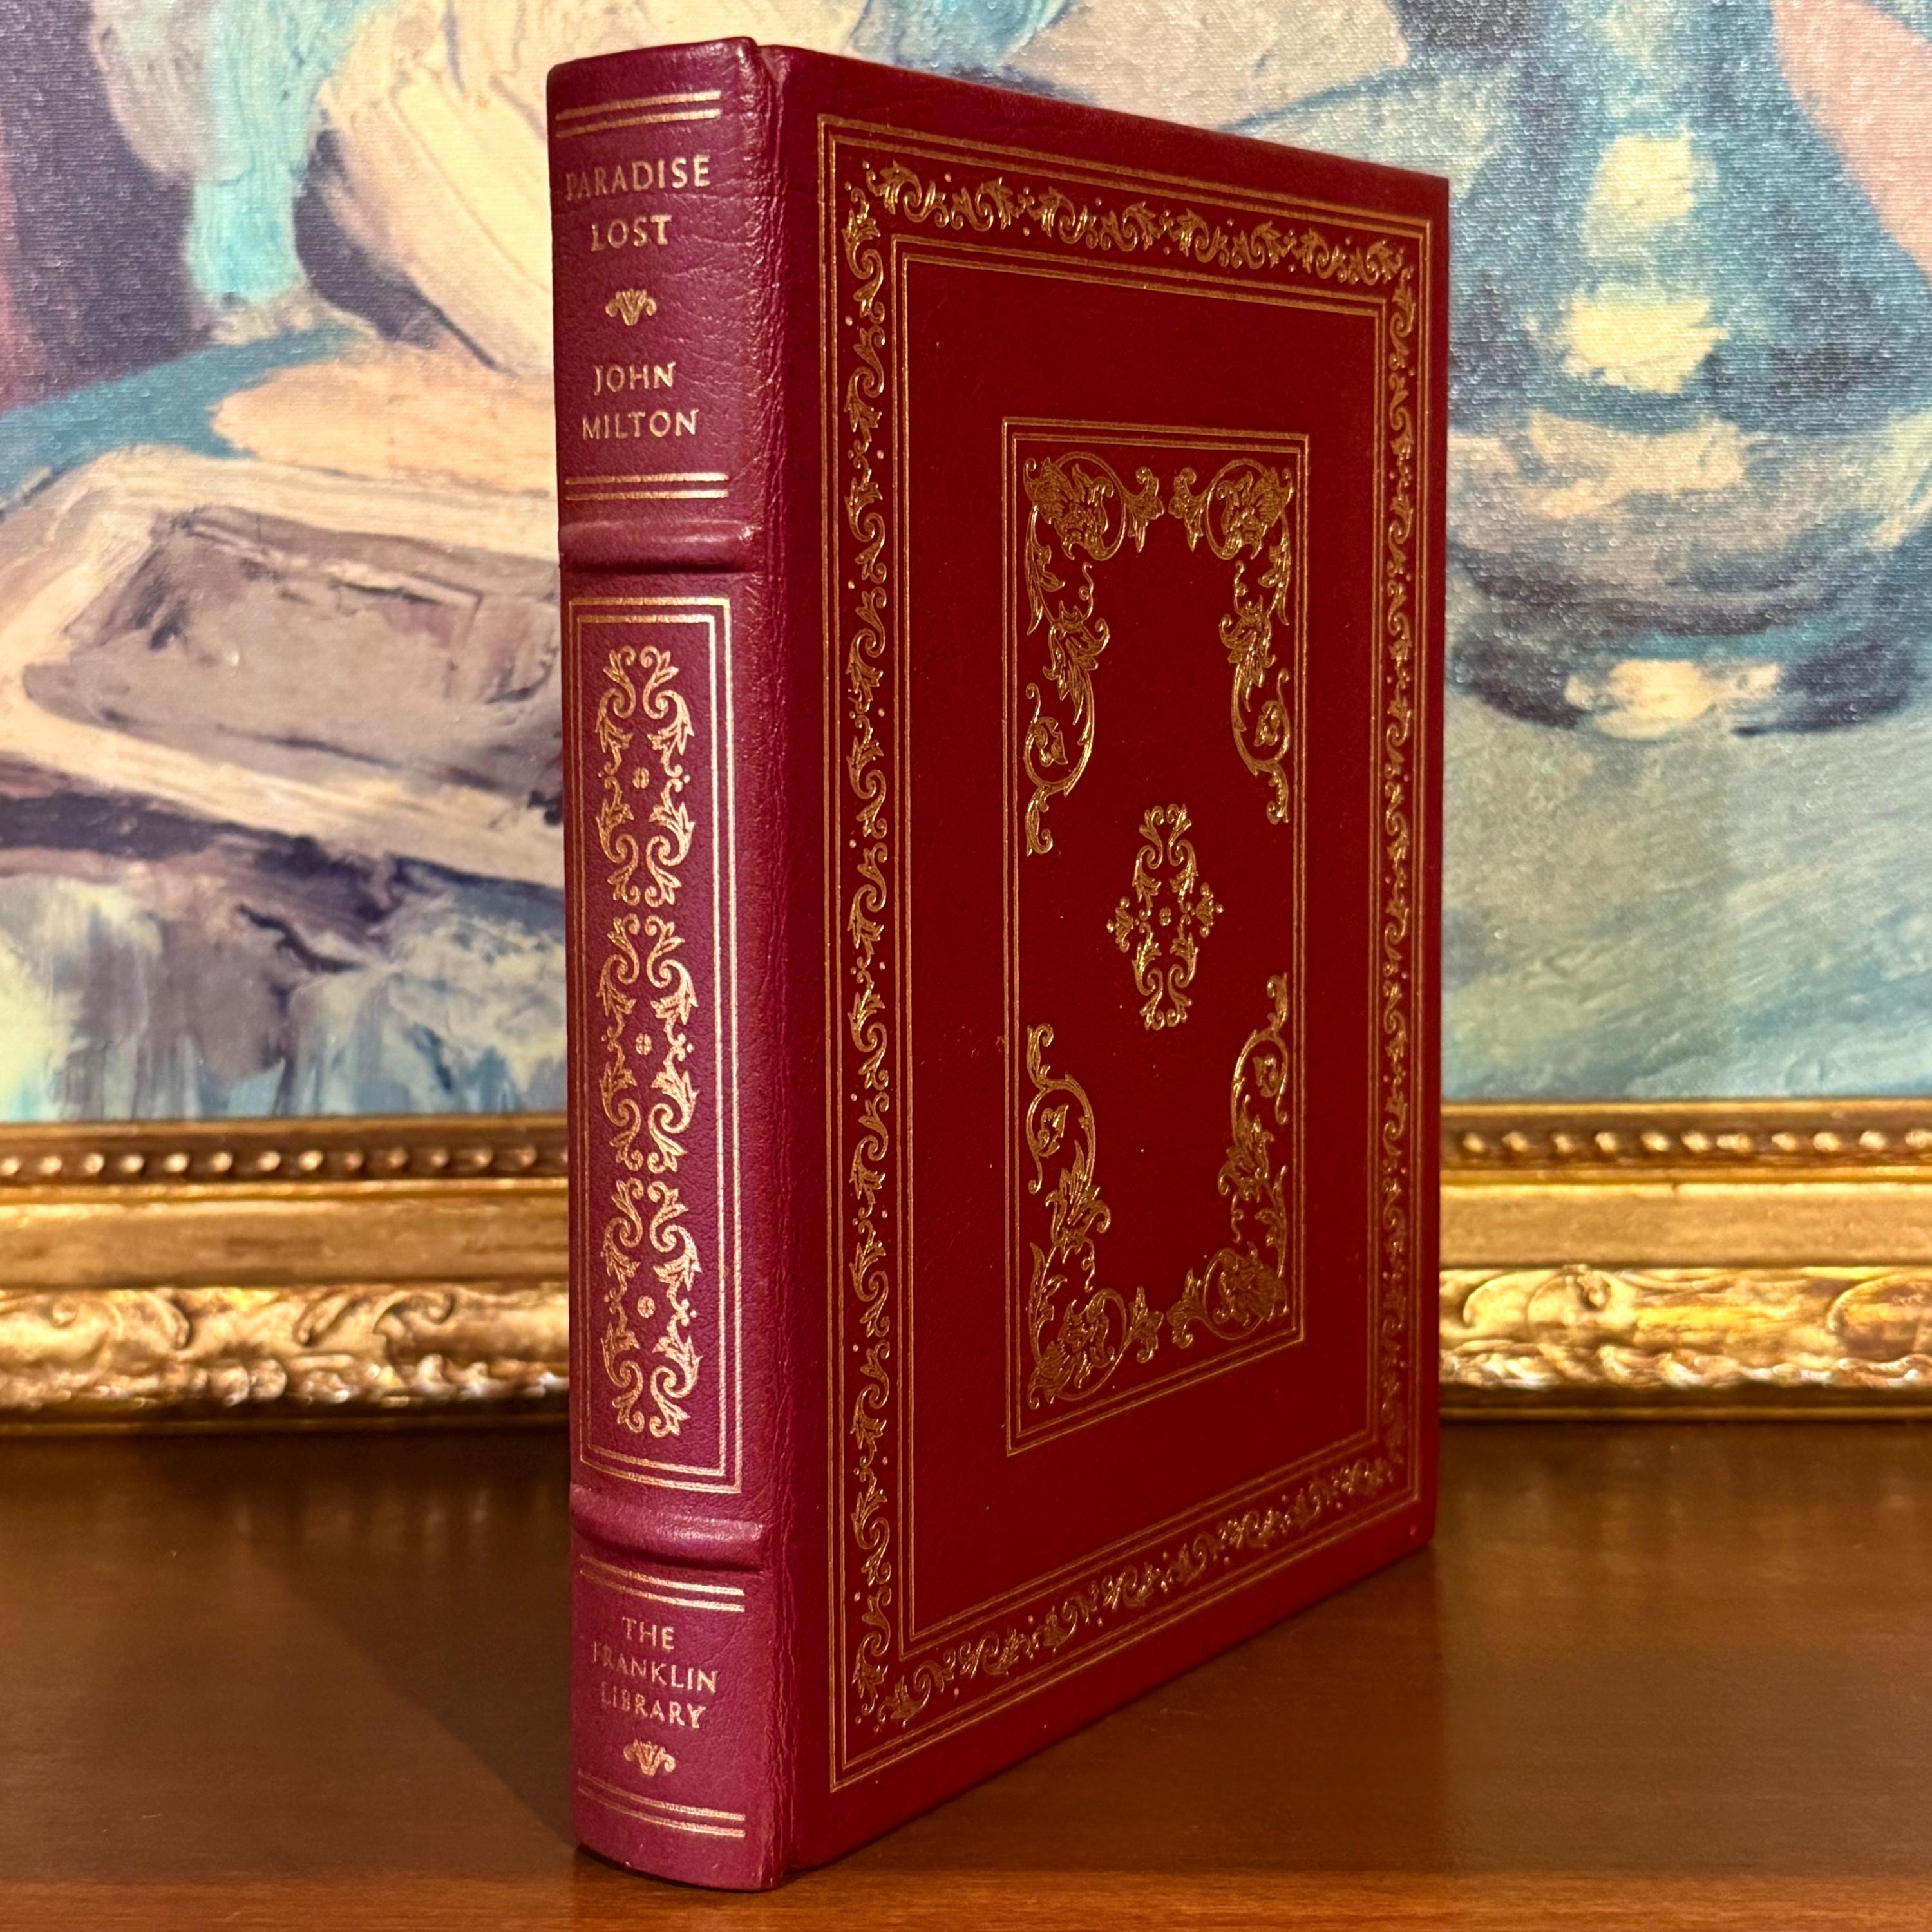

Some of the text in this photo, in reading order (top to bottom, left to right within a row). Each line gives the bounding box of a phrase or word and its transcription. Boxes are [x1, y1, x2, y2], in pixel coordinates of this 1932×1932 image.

[565, 154, 710, 201] PARADISE
[591, 215, 672, 252] LOST
[592, 361, 676, 397] JOHN
[582, 408, 699, 440] MILTON
[622, 1616, 675, 1651] THE
[601, 1681, 706, 1729] LIBRARY
